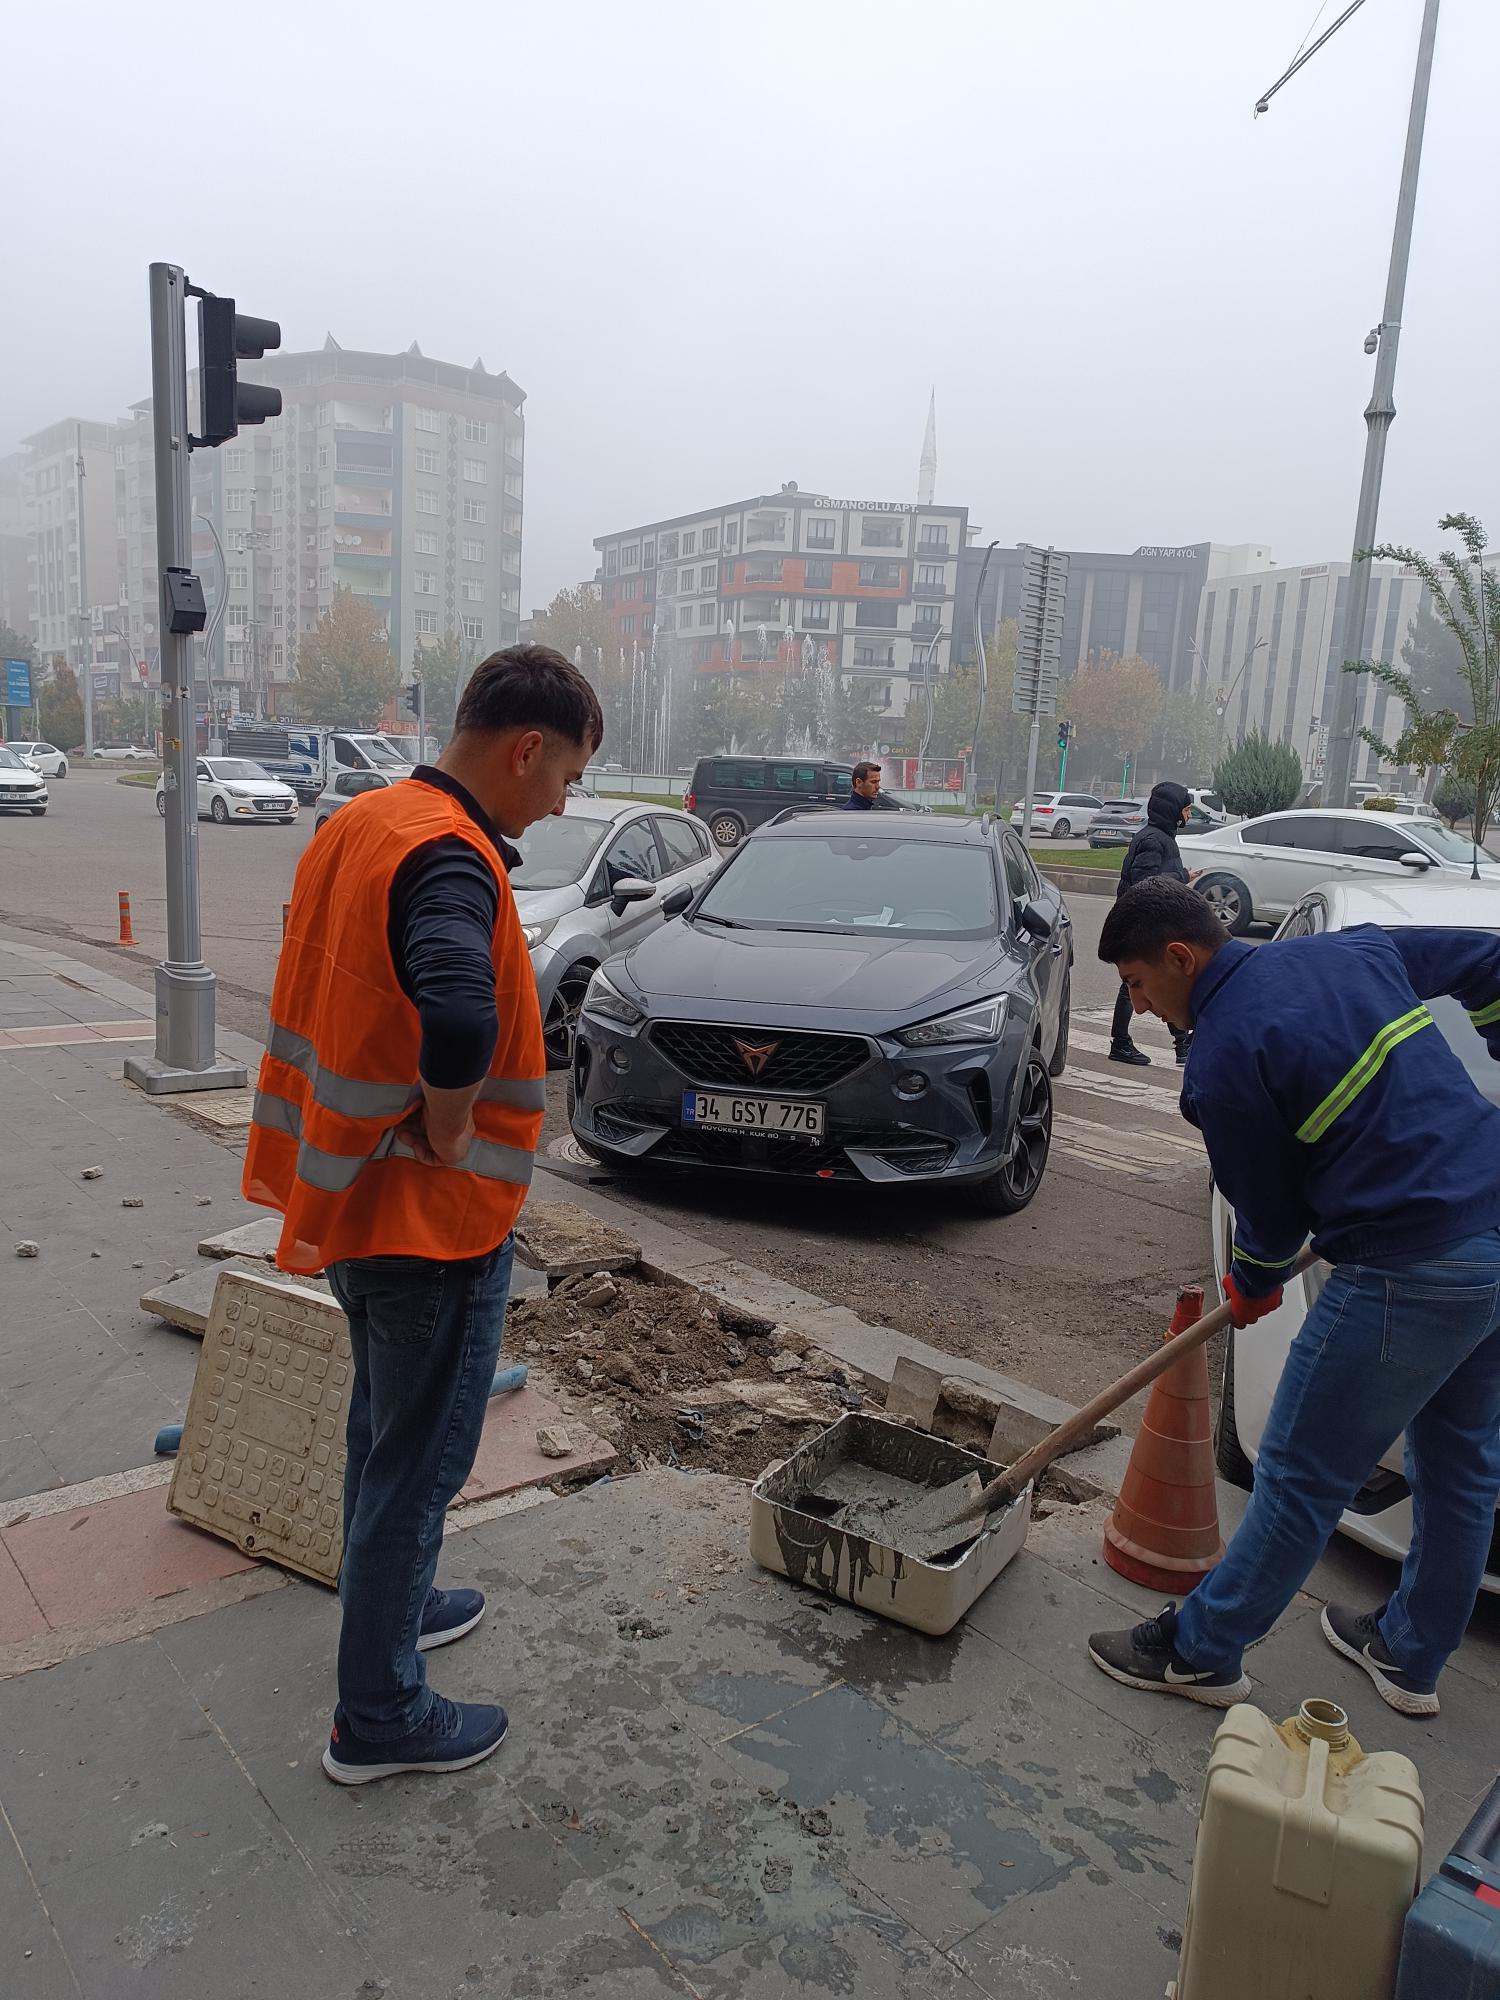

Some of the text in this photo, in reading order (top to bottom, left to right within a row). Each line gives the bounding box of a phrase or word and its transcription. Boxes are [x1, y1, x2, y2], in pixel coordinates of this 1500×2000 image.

[894, 504, 919, 513] APT.
[1140, 547, 1157, 557] DGN
[1159, 548, 1176, 558] YAPI
[697, 1097, 818, 1130] 34 GSY 776
